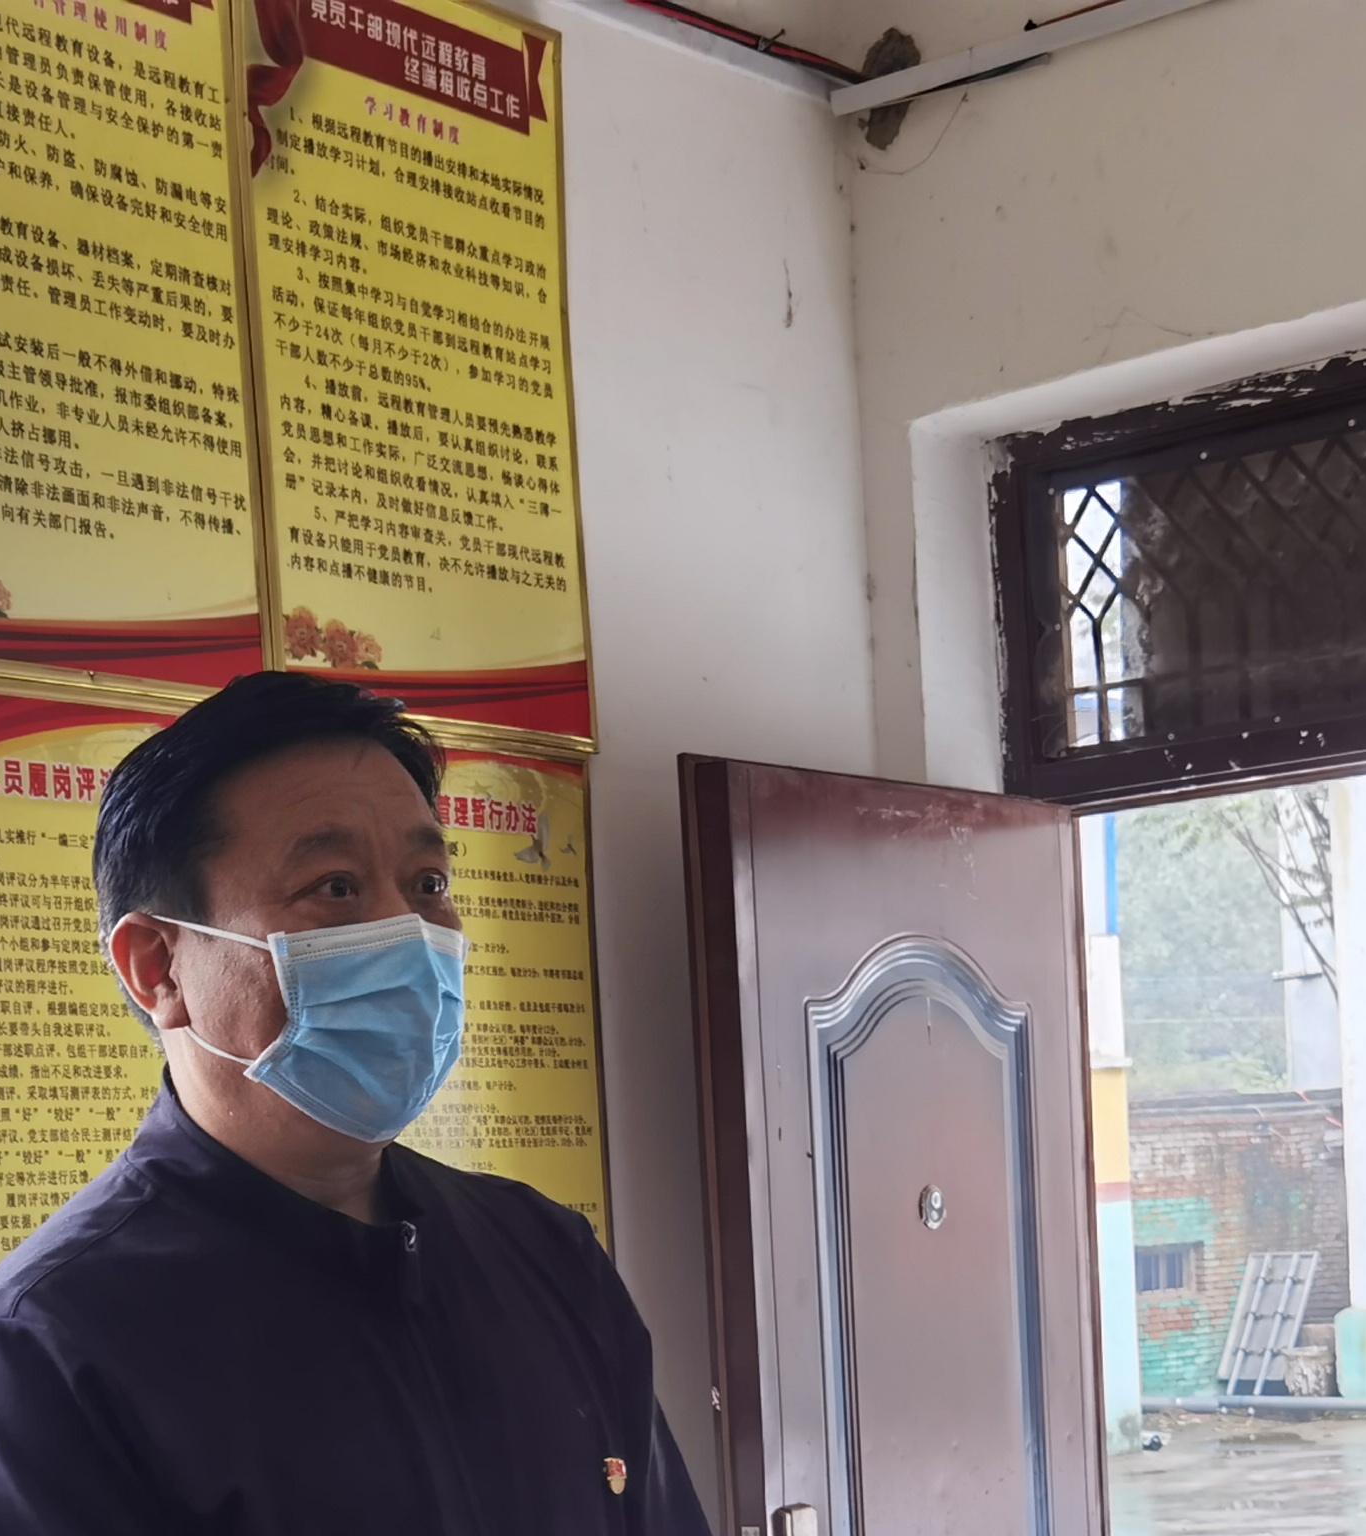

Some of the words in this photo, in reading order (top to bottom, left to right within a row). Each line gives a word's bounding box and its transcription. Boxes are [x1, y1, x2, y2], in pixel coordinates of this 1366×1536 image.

[404, 55, 521, 120] 终端接收点工作
[364, 95, 460, 146] 学习教育制度
[6, 1193, 76, 1209] 履岗评议情况
